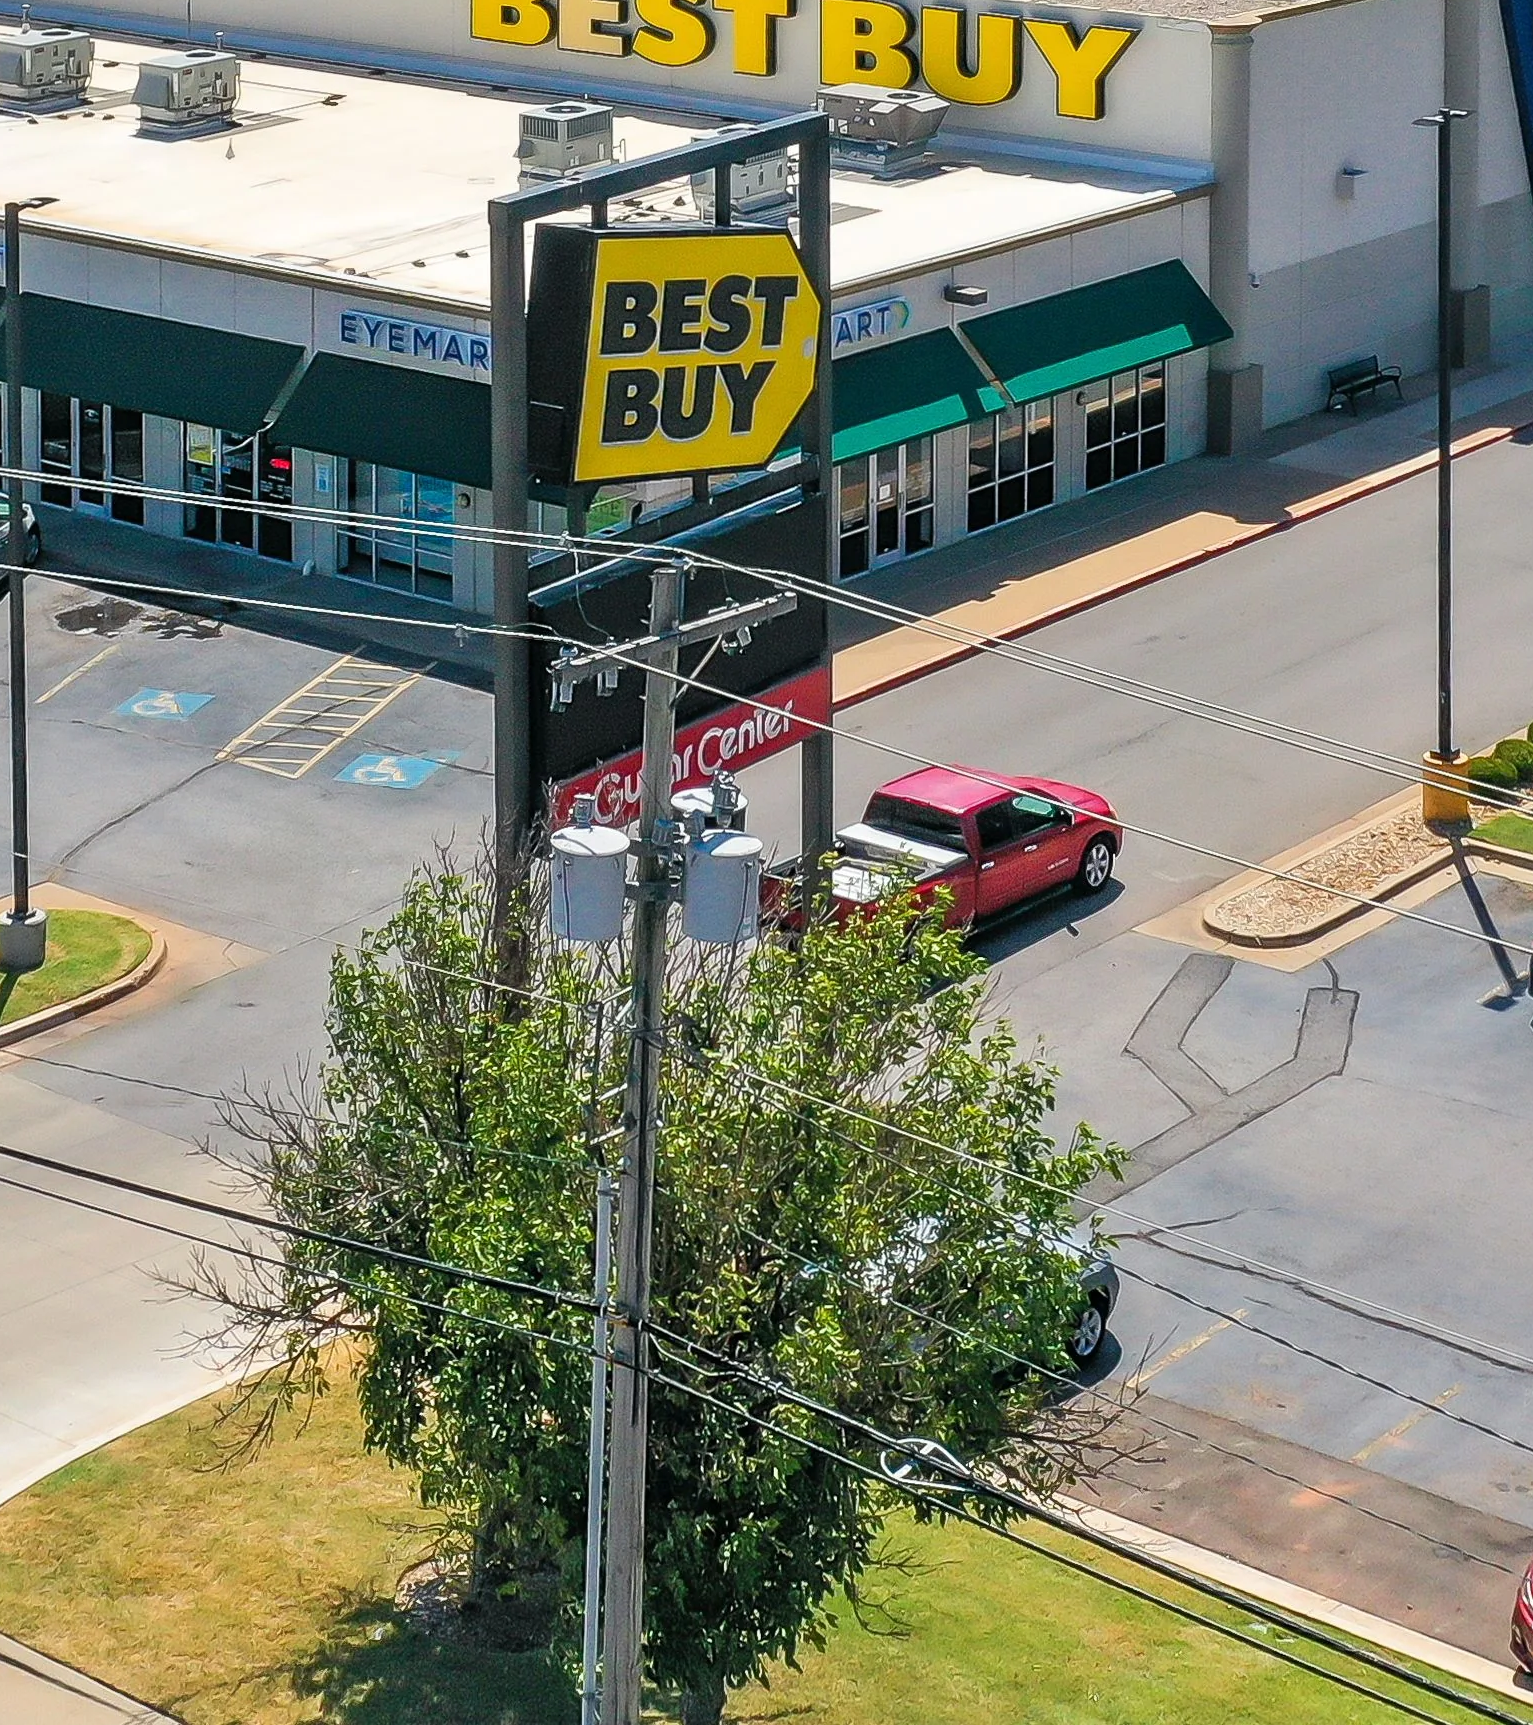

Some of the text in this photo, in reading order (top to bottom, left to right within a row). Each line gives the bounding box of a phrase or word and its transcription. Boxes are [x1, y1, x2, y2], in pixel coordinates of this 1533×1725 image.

[341, 312, 491, 372] EYEMAR
[598, 273, 800, 359] BEST
[600, 360, 778, 447] BUY
[697, 698, 795, 776] Center
